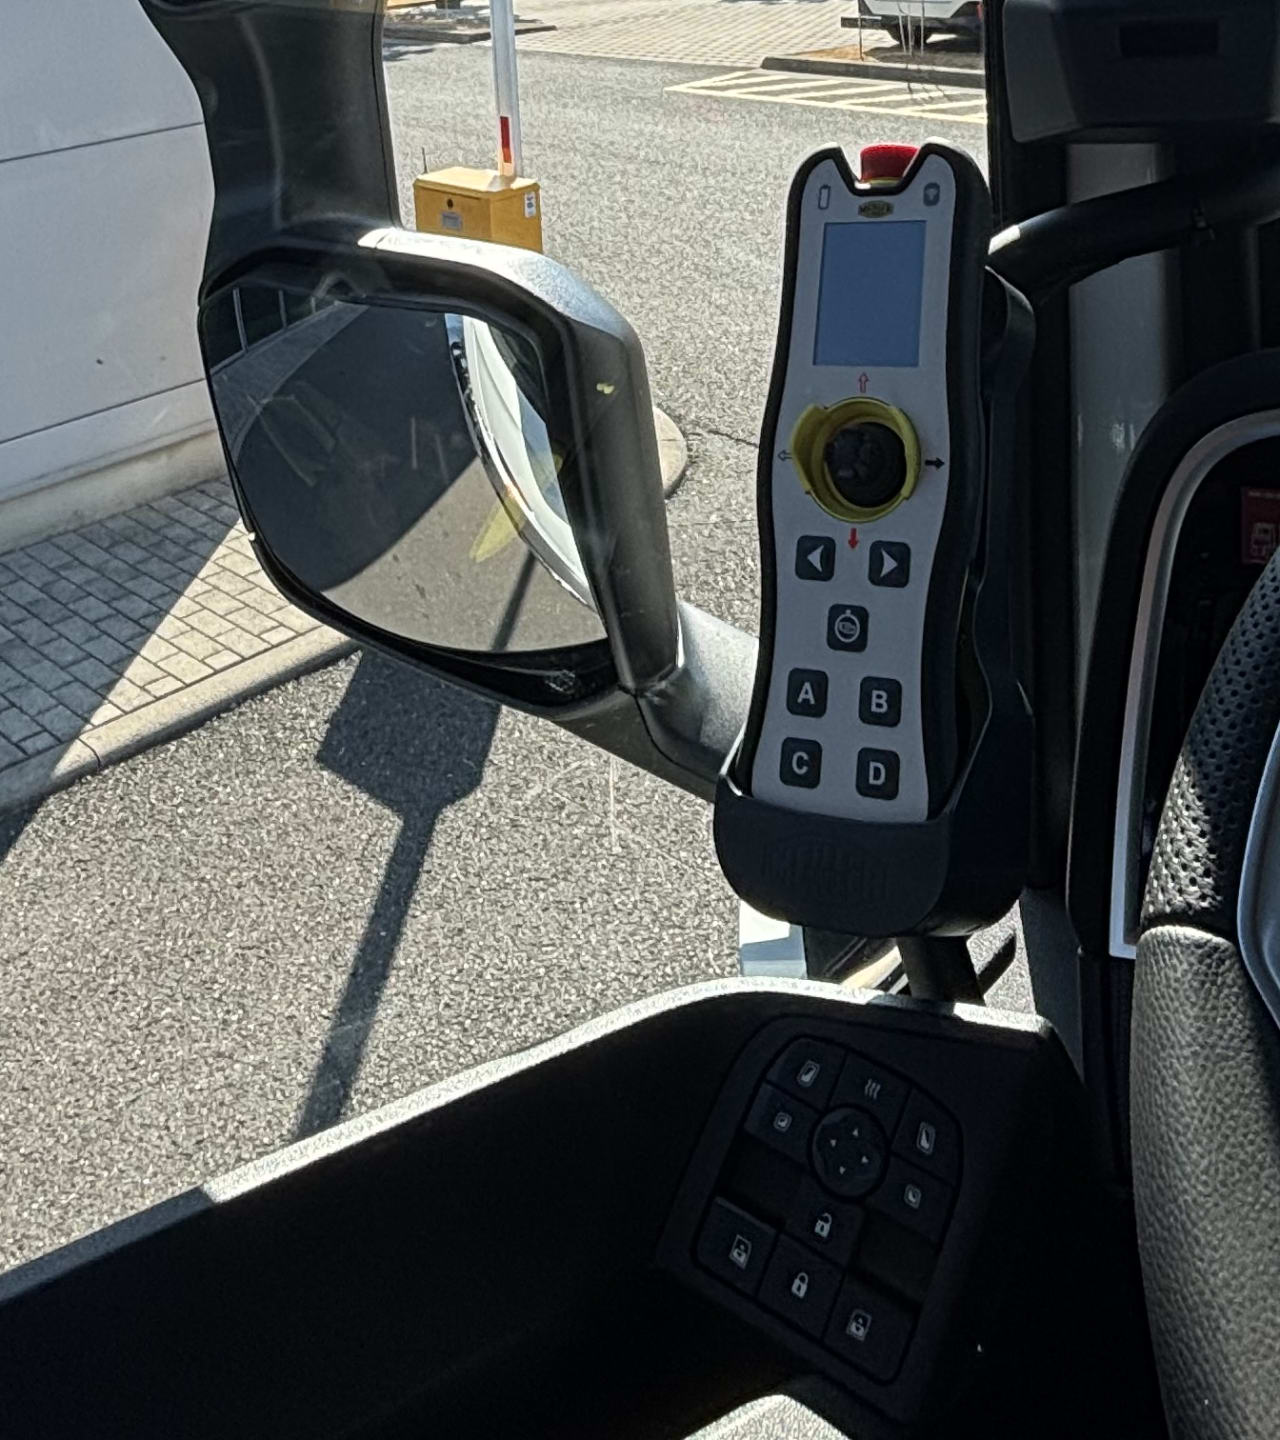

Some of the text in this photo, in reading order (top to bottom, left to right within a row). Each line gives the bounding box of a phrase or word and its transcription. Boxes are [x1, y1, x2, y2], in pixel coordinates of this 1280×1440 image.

[797, 681, 816, 705] A
[870, 689, 889, 714] B
[791, 751, 810, 776] C
[868, 761, 887, 786] D
